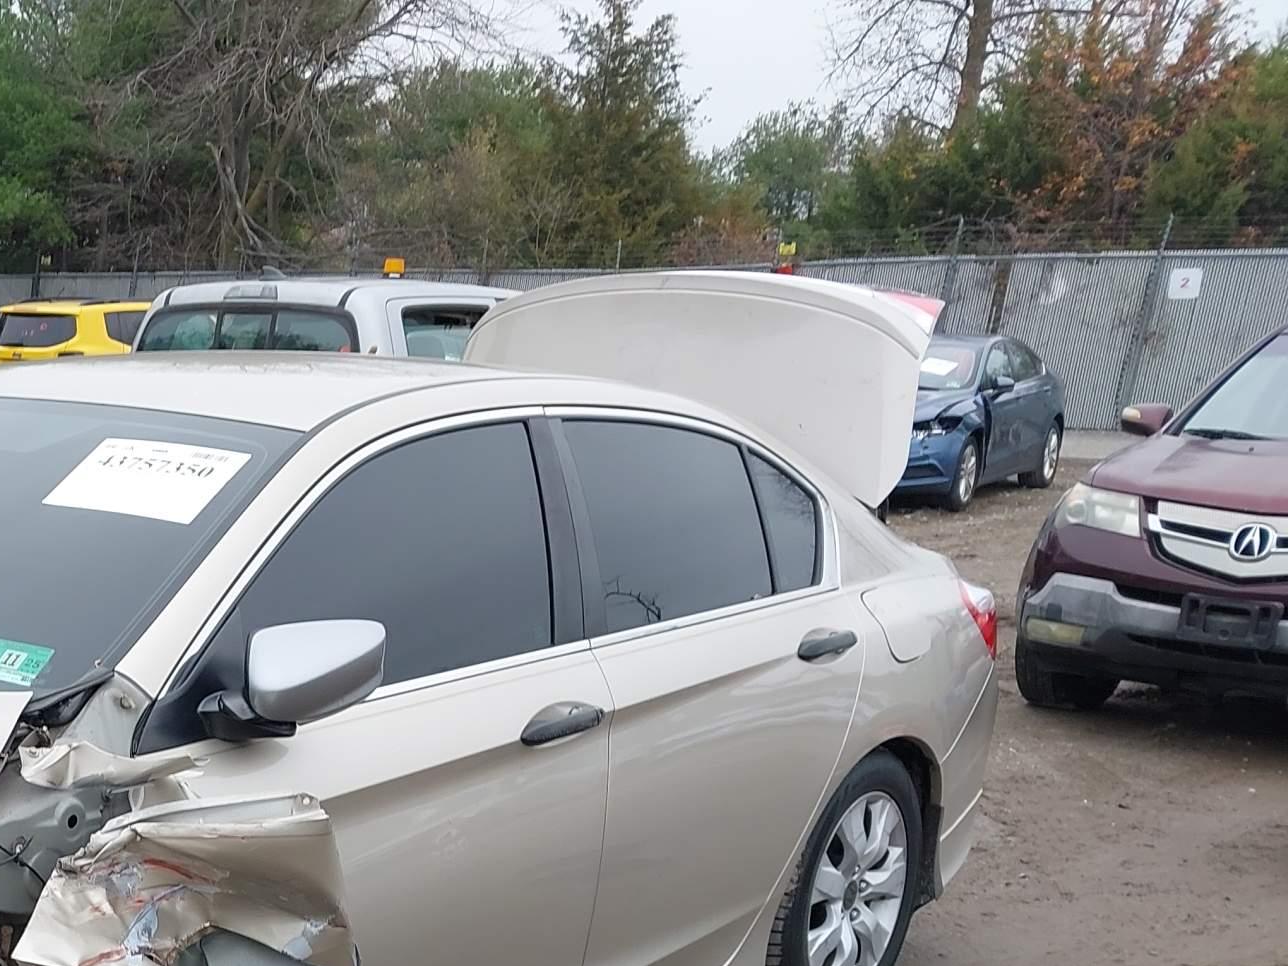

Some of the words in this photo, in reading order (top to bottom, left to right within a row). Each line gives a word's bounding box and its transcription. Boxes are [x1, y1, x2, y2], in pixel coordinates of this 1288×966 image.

[1179, 276, 1190, 289] 2
[98, 454, 215, 478] 43757350
[1, 652, 19, 667] 11
